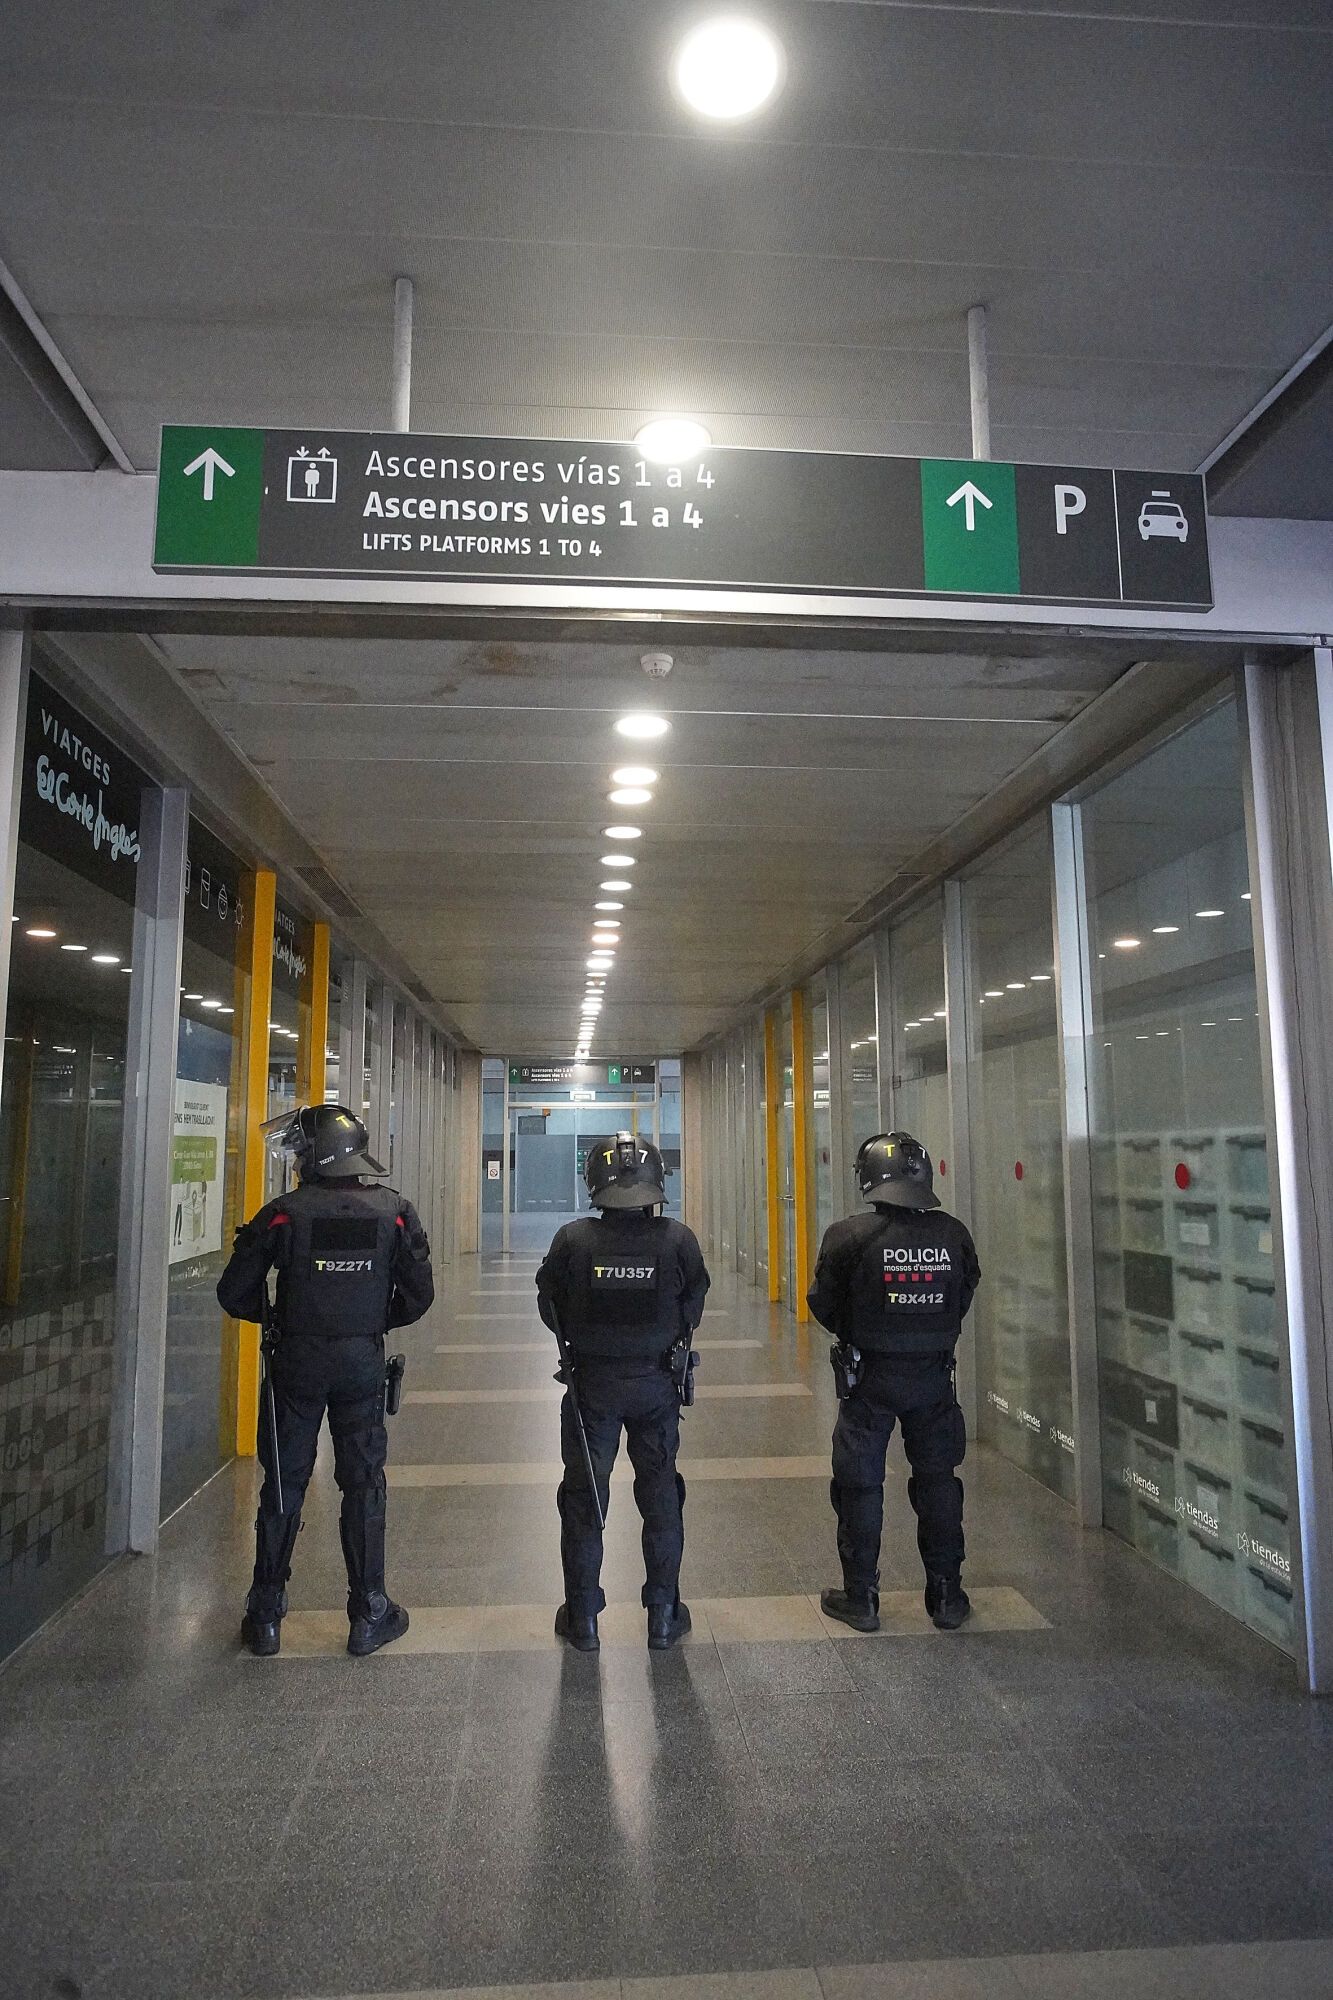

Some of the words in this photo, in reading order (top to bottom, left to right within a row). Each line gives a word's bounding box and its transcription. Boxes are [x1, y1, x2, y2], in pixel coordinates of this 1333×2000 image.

[365, 450, 545, 483] Ascensores
[557, 456, 621, 486] vías
[635, 460, 651, 487] 1
[666, 466, 682, 488] a
[696, 463, 715, 489] 4
[363, 491, 529, 523] Ascensors
[541, 495, 606, 525] vies
[619, 500, 638, 526] 1
[651, 505, 669, 528] a
[682, 502, 704, 529] 4
[1054, 484, 1087, 535] P
[363, 533, 412, 551] LIFTS
[420, 535, 531, 555] PLATFORMS
[539, 538, 551, 556] 1
[558, 539, 582, 557] TO
[589, 540, 602, 557] 4
[41, 708, 110, 786] VIATGES
[36, 754, 55, 804] El
[55, 772, 94, 832] Corte
[93, 789, 141, 863] Inglés
[335, 1114, 350, 1128] T
[603, 1149, 614, 1165] T
[639, 1149, 648, 1164] 7
[883, 1144, 895, 1157] T
[315, 1260, 372, 1272] T9Z271
[883, 1248, 951, 1263] POLICIA
[594, 1266, 655, 1279] T7U357
[913, 1263, 951, 1273] d'esquadra
[888, 1292, 944, 1304] T8X412
[1057, 1429, 1075, 1448] tienda
[1133, 1471, 1160, 1496] tiendas
[1186, 1501, 1218, 1530] tiendas
[1251, 1539, 1290, 1572] tiendas
